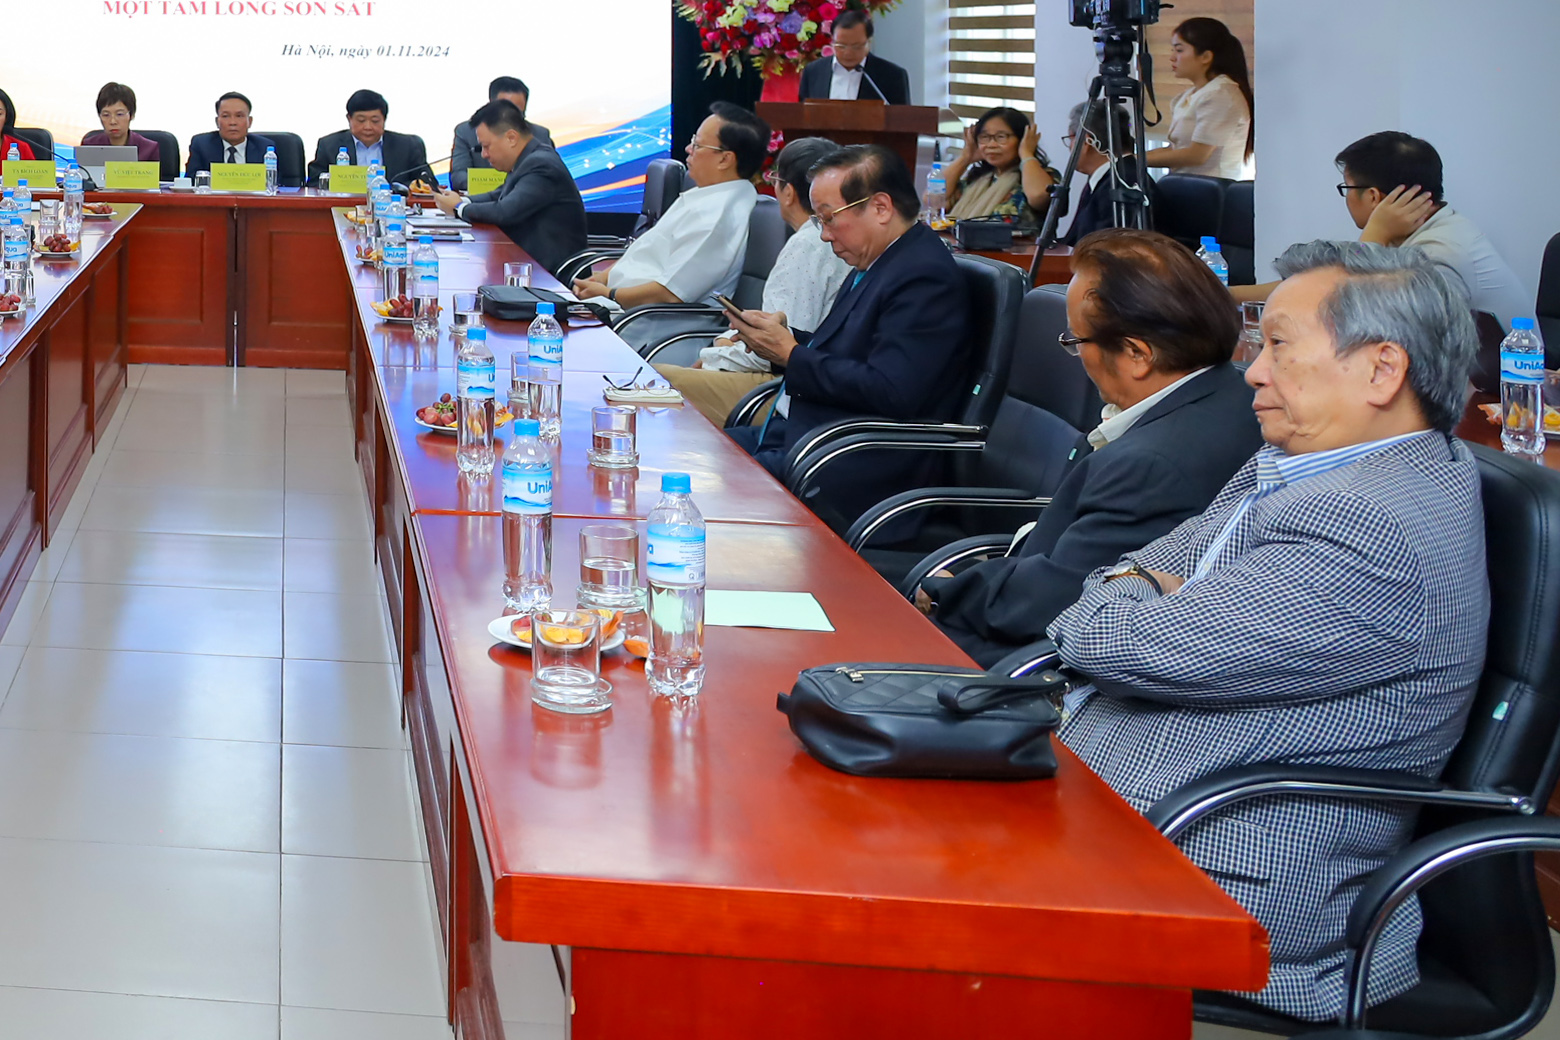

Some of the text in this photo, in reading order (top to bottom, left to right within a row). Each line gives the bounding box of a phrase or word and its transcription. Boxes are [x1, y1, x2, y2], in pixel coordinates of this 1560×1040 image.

[283, 1, 327, 16] SON
[281, 44, 451, 59] Hà Nội, ngày 01.11.2024
